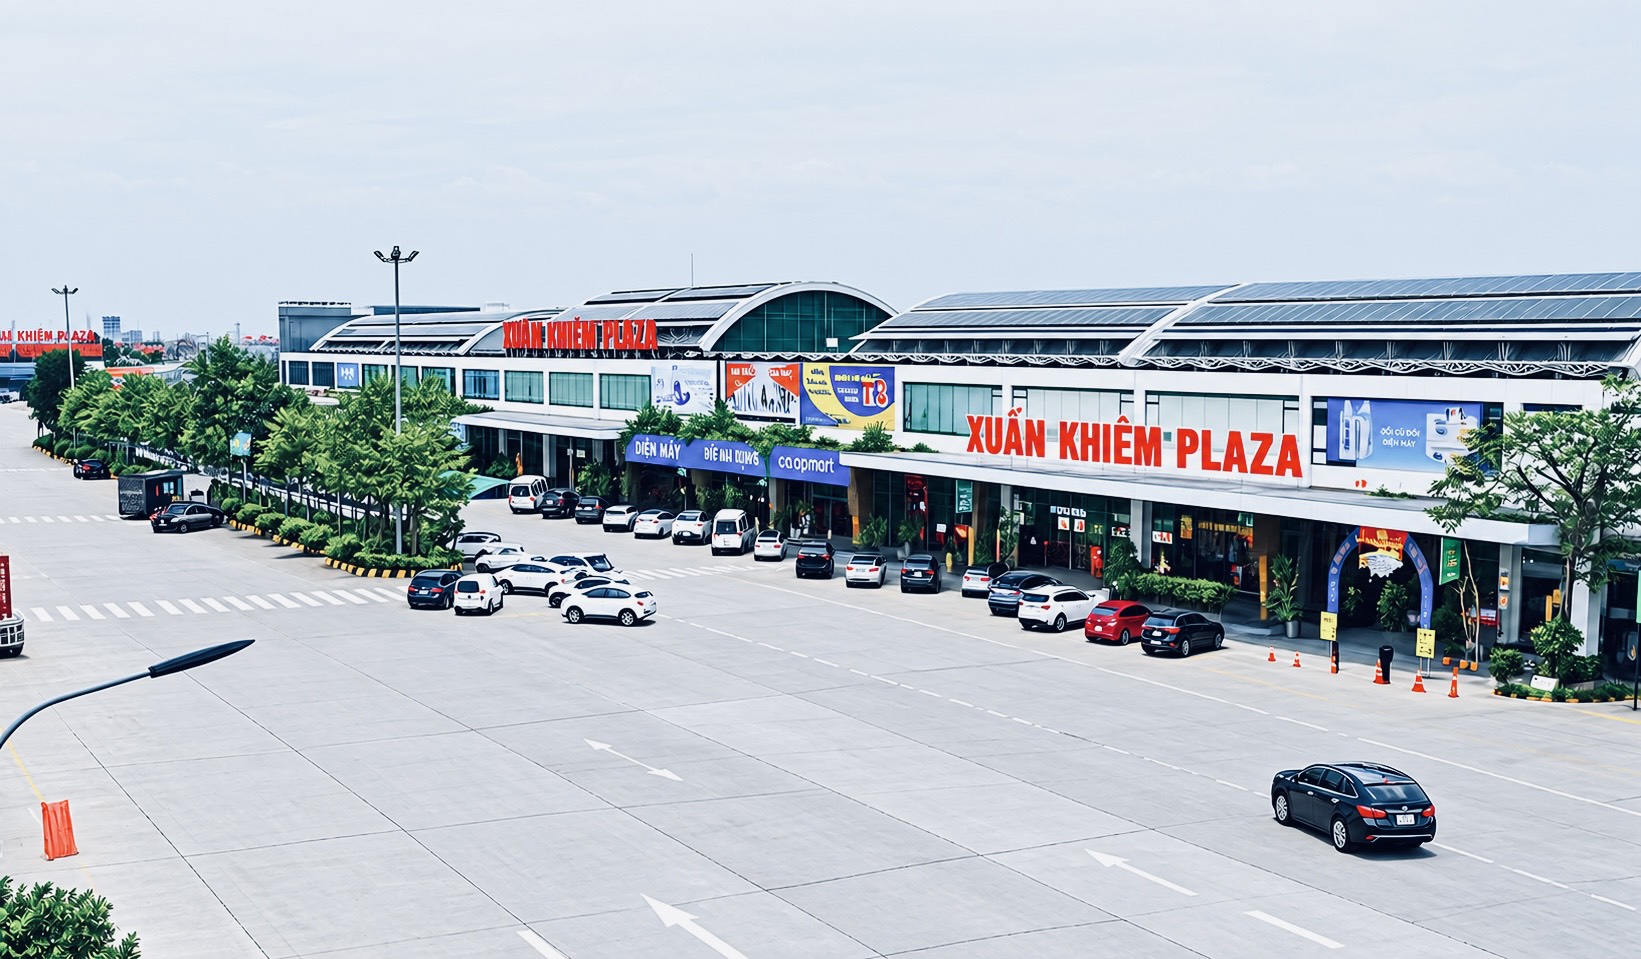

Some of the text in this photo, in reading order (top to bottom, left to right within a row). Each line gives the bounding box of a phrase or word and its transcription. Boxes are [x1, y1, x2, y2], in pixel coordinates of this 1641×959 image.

[602, 318, 658, 351] PLAZA
[659, 439, 682, 460] MÁY
[1059, 415, 1162, 467] KHIÊM
[1176, 428, 1303, 478] PLAZA
